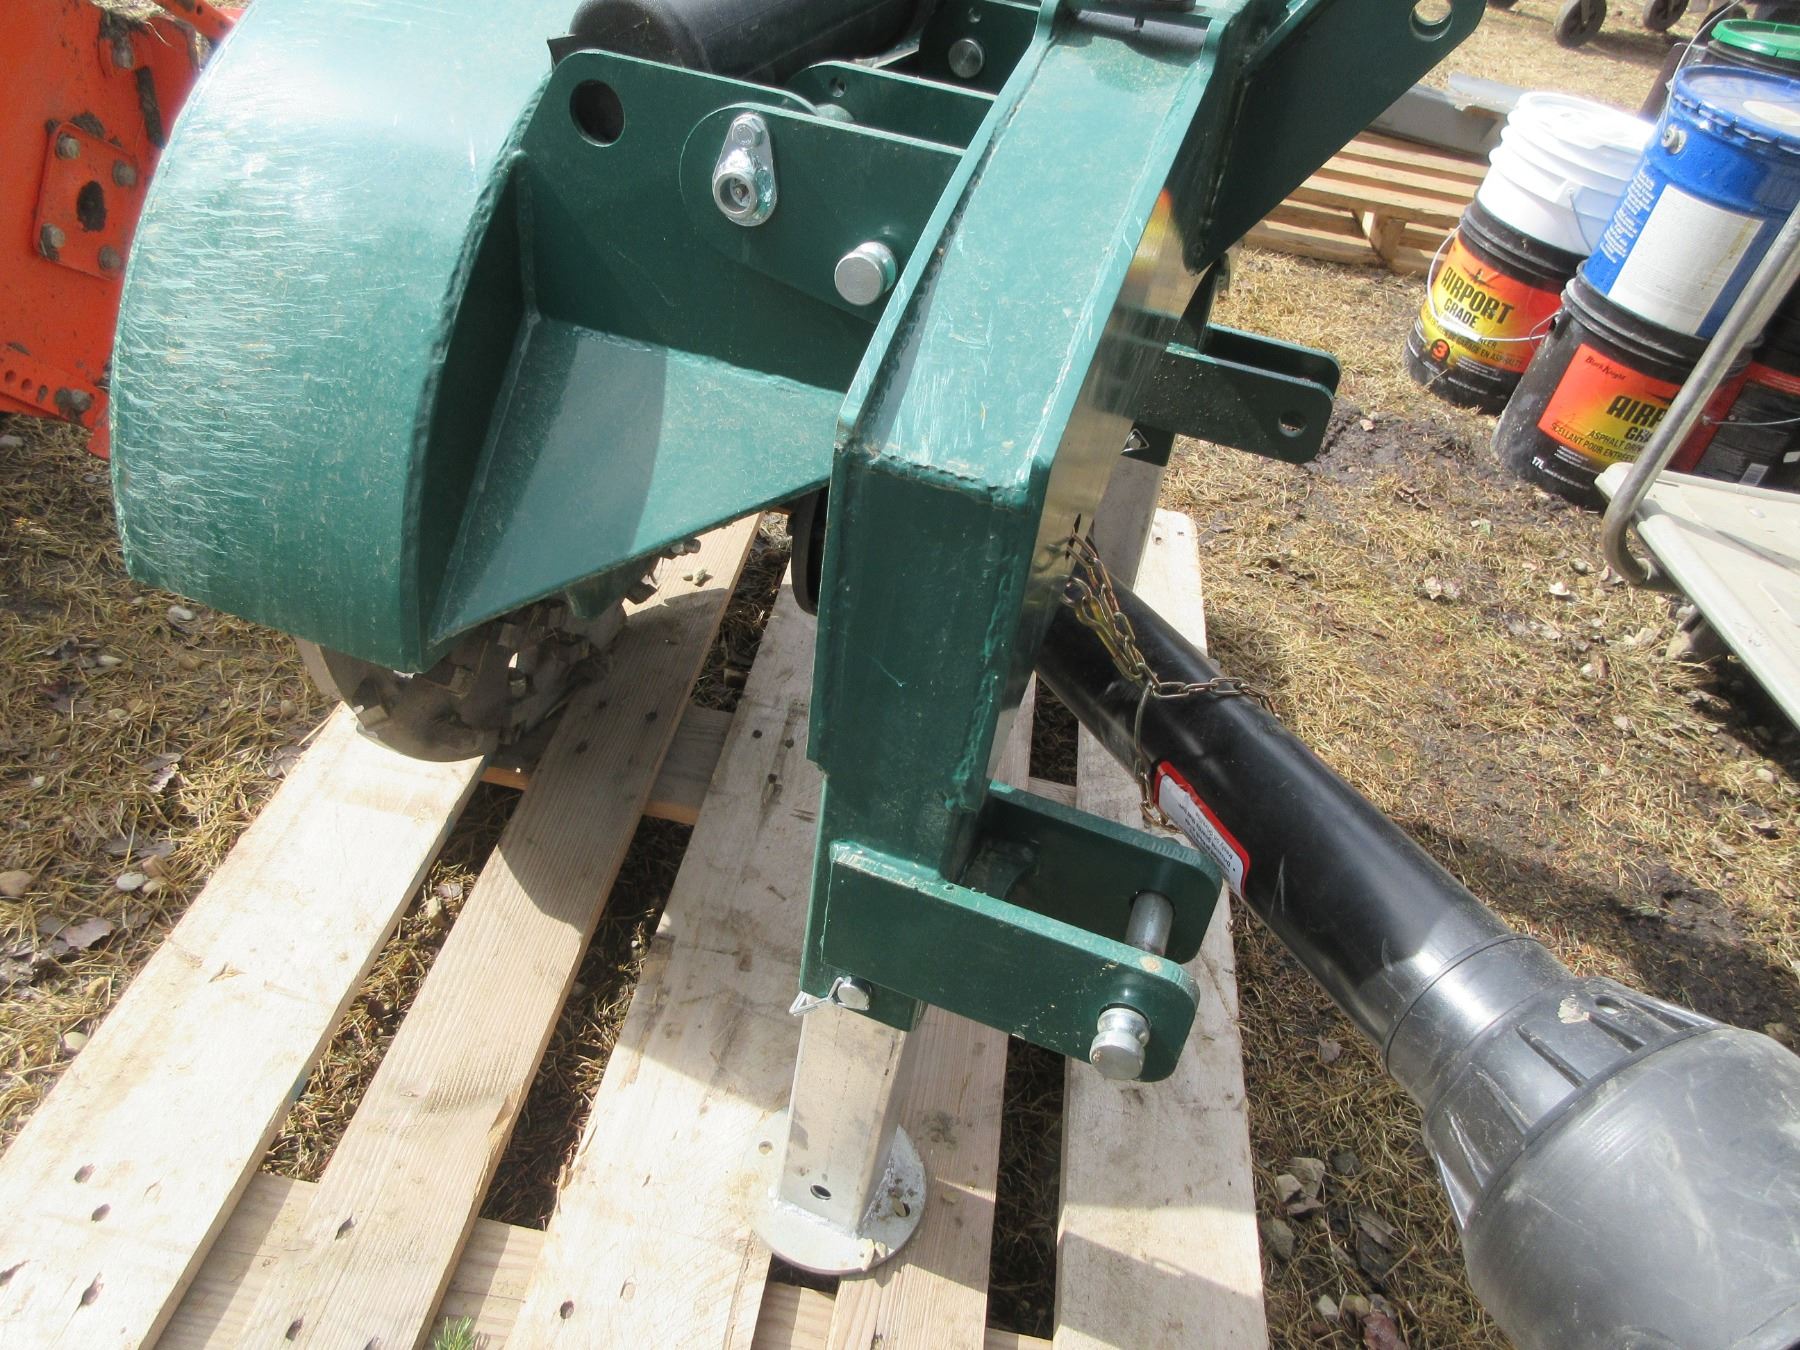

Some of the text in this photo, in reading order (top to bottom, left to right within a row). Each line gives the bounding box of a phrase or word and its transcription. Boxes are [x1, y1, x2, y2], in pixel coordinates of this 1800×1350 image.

[1441, 266, 1514, 324] AIRPORT
[1444, 298, 1480, 328] GRADE
[1432, 340, 1449, 358] 3
[1606, 395, 1668, 428] AIRP
[1551, 422, 1584, 445] SCELLANT
[1583, 440, 1604, 455] POUR
[1587, 430, 1625, 450] ASPHALT
[1531, 456, 1545, 470] 17L
